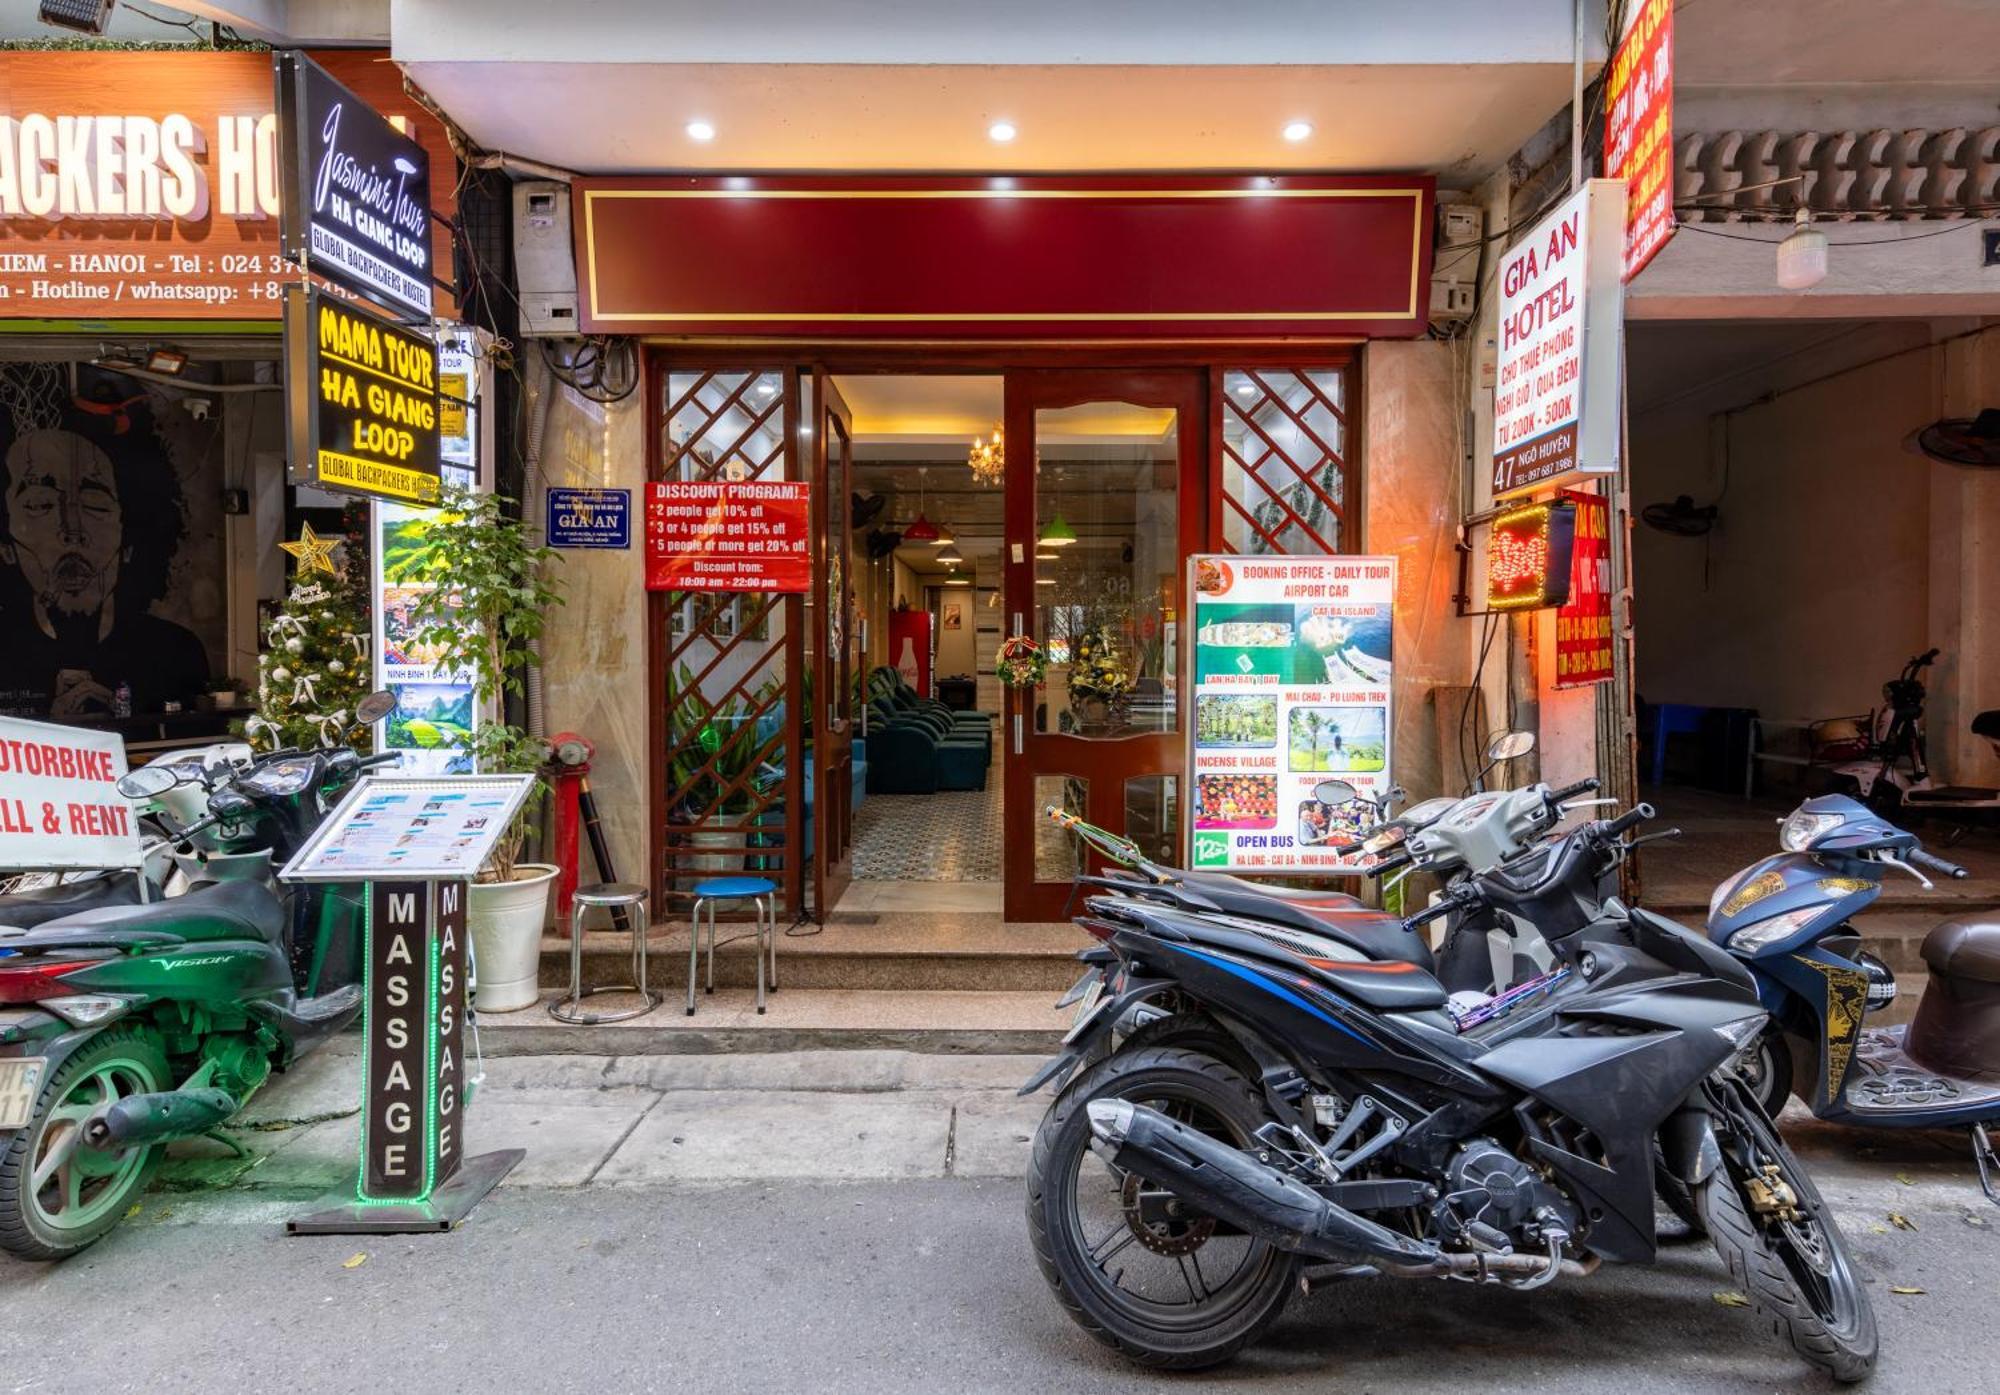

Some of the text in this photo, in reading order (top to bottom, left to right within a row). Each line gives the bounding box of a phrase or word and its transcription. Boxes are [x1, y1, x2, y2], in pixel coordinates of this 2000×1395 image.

[315, 103, 424, 237] Jasmine Tour
[332, 193, 426, 269] HA GIANG LOOP
[69, 254, 147, 273] HANOI
[171, 254, 200, 273] Tel
[222, 255, 262, 273] 024
[1504, 247, 1538, 299] GIA
[1545, 211, 1579, 272] AN
[313, 228, 345, 262] GLOBAL
[348, 246, 401, 294] BACKPACKERS
[400, 276, 427, 308] HOSTEL
[32, 280, 110, 299] Hotline
[131, 280, 239, 304] whatsapp:
[249, 281, 283, 300] +8
[1504, 277, 1574, 351] HOTEL
[320, 307, 433, 388] MAMA TOUR
[1502, 363, 1518, 386] CHO
[322, 368, 434, 430] HA GIANG
[1511, 411, 1535, 441] 200K
[1545, 394, 1572, 425] 500K
[353, 419, 414, 460] LOOP
[323, 455, 354, 481] GLOBAL
[357, 464, 410, 490] BACKPACKERS
[1494, 456, 1515, 490] 47
[656, 485, 799, 499] DISCOUNT PROGRAM!
[594, 515, 618, 528] AN
[656, 505, 764, 517] 2 people get 10% off
[657, 522, 785, 535] 3 or 4 people get 15% off
[657, 539, 805, 552] 5 people or more get 20% off
[694, 562, 763, 572] Discount from:
[1243, 566, 1288, 579] BOOKING
[1291, 566, 1324, 579] OFFICE
[1334, 566, 1362, 579] DAILY
[1365, 566, 1390, 578] TOUR
[761, 579, 777, 587] pm
[1284, 585, 1349, 598] AIRPORT CAR
[387, 670, 405, 679] NINH
[1367, 692, 1386, 701] TREK
[1197, 757, 1277, 768] INCENSE VILLAGE
[0, 799, 129, 837] LL & RENT
[1236, 836, 1294, 848] OPEN BUS
[438, 883, 458, 1158] MASSAGE
[384, 893, 415, 1176] MASSAGE
